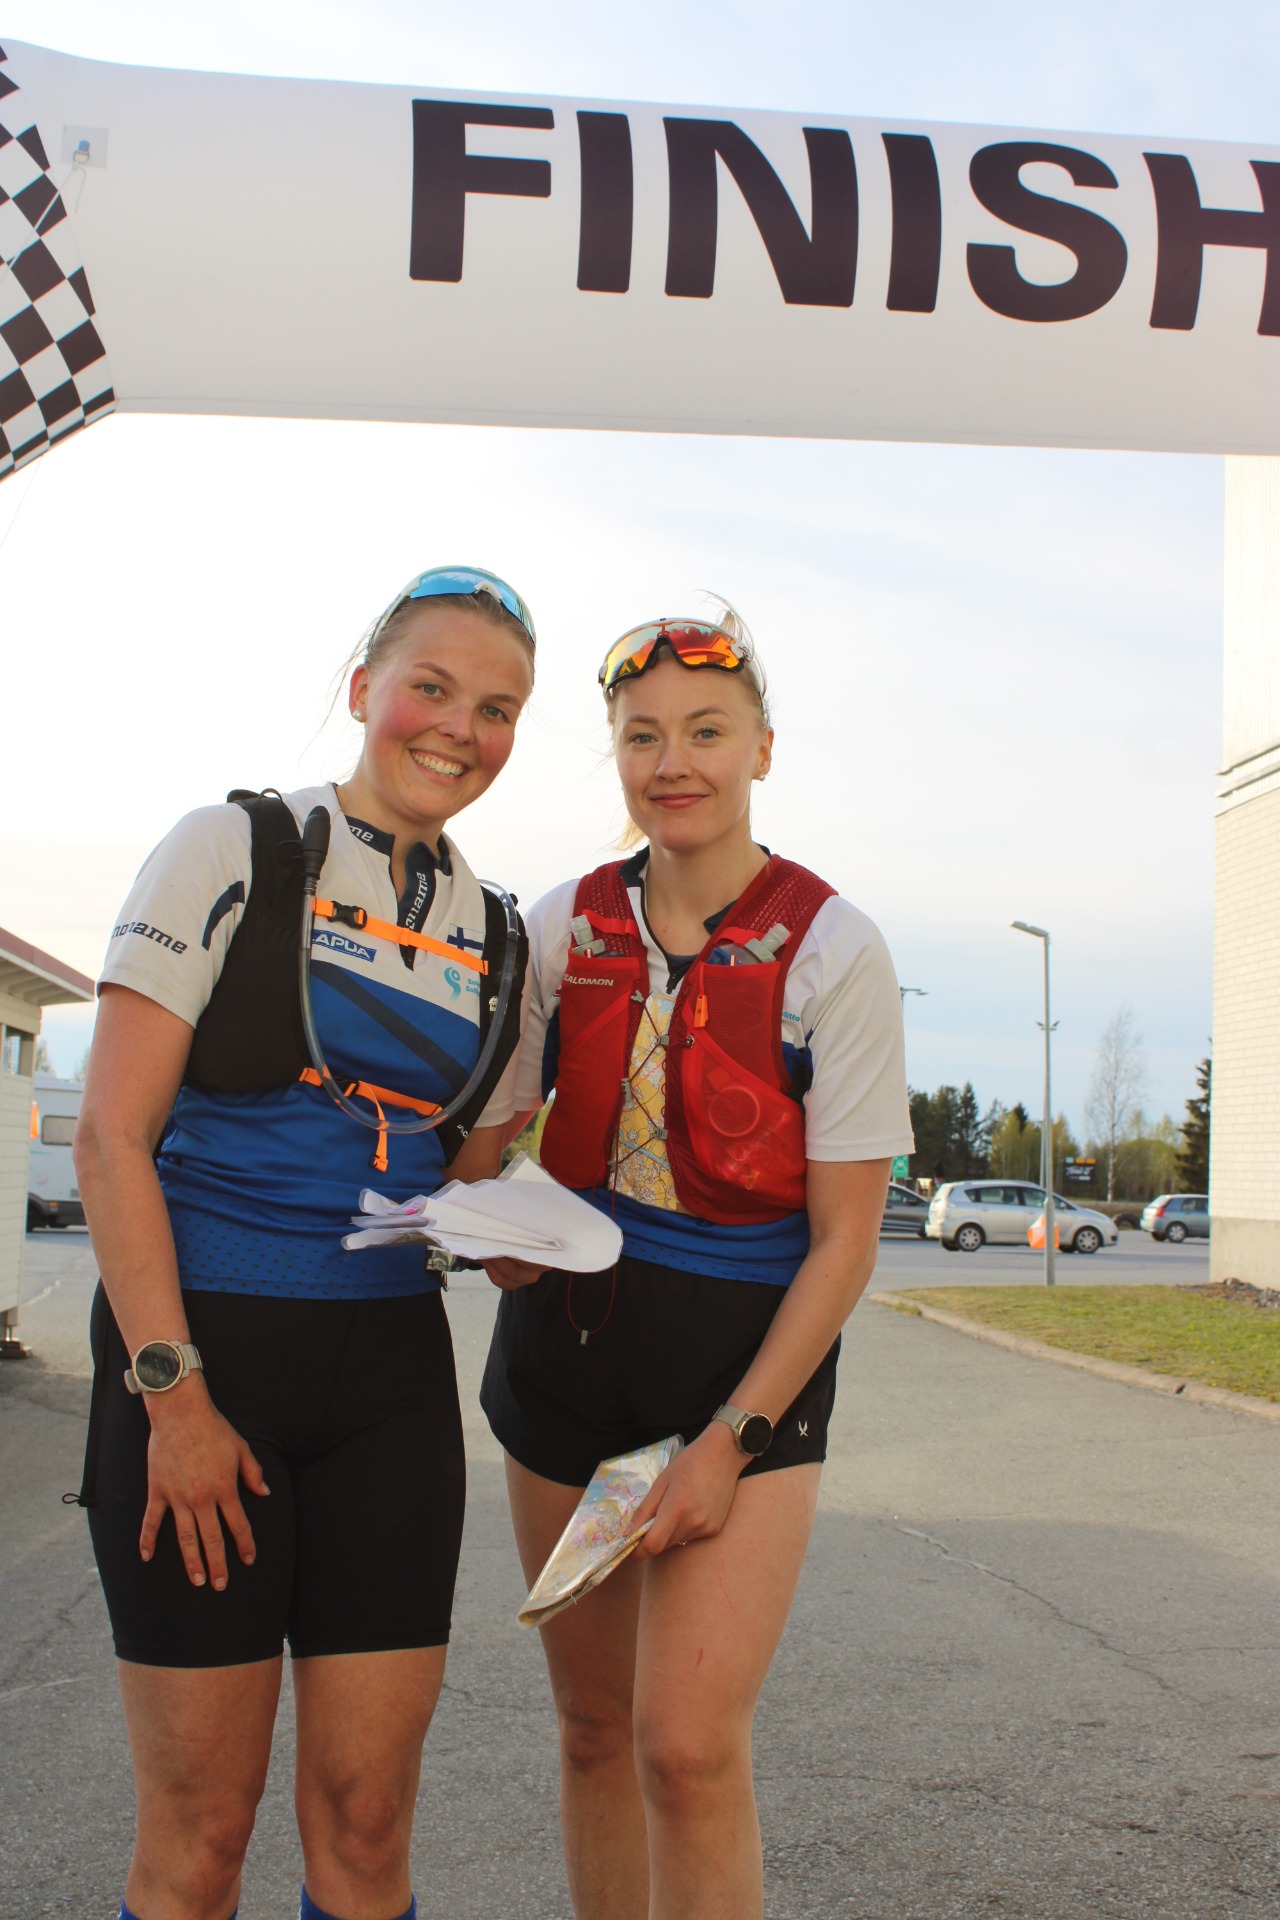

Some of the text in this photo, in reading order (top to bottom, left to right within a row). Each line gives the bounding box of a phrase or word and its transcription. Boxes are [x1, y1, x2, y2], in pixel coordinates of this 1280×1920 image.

[409, 98, 1280, 337] FINISH
[312, 933, 371, 959] APUA
[563, 973, 614, 987] SALOMON
